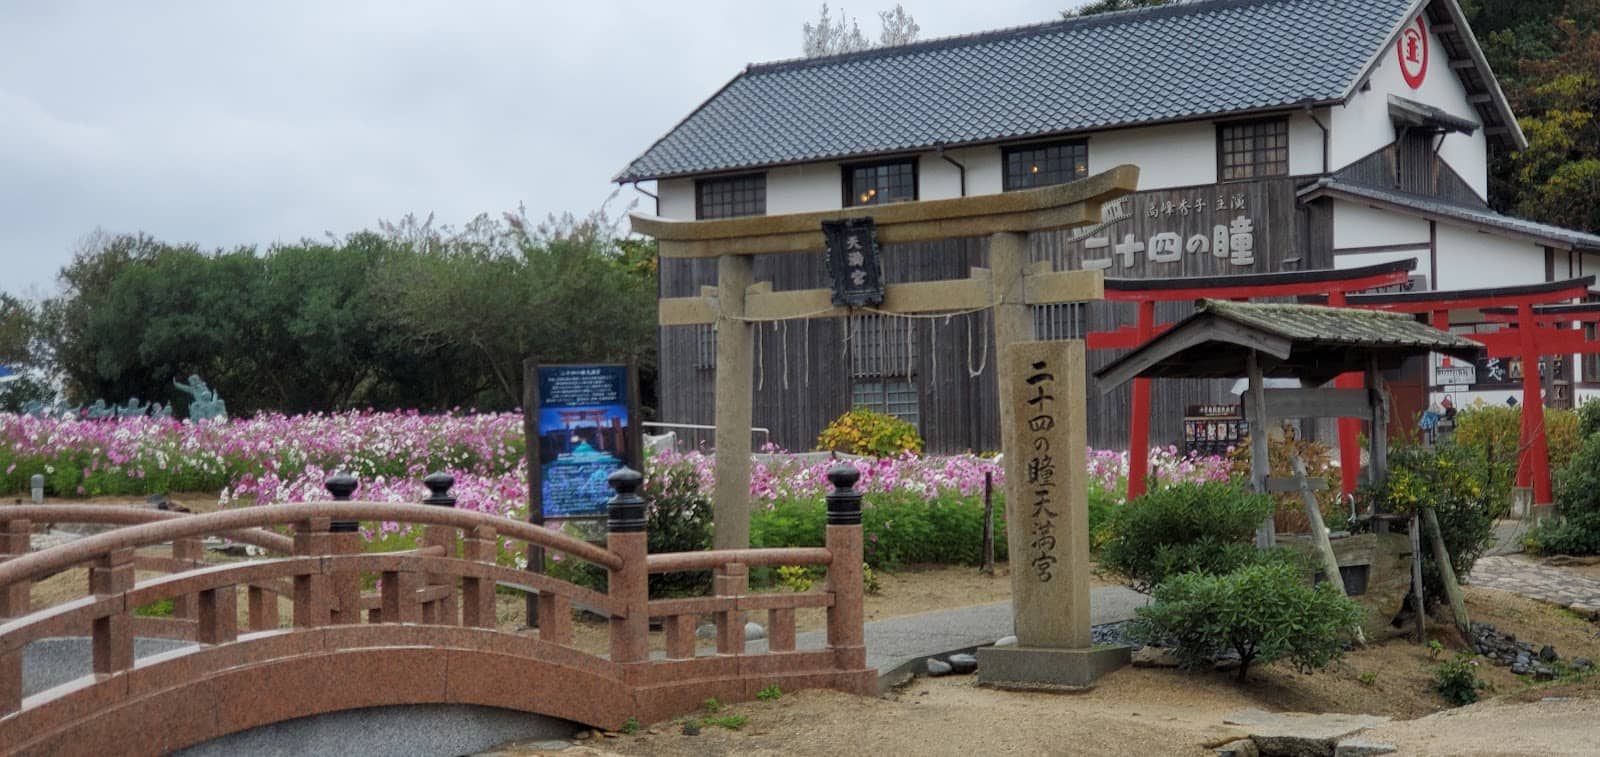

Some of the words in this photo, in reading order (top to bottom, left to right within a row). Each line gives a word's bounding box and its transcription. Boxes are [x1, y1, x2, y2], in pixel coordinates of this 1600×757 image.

[1146, 198, 1207, 218] 高峰秀子
[1215, 193, 1246, 211] 主演
[847, 235, 868, 286] 天満宮
[1081, 215, 1255, 270] 二十四の瞳
[1026, 361, 1058, 583] 二十四の瞳天満宮
